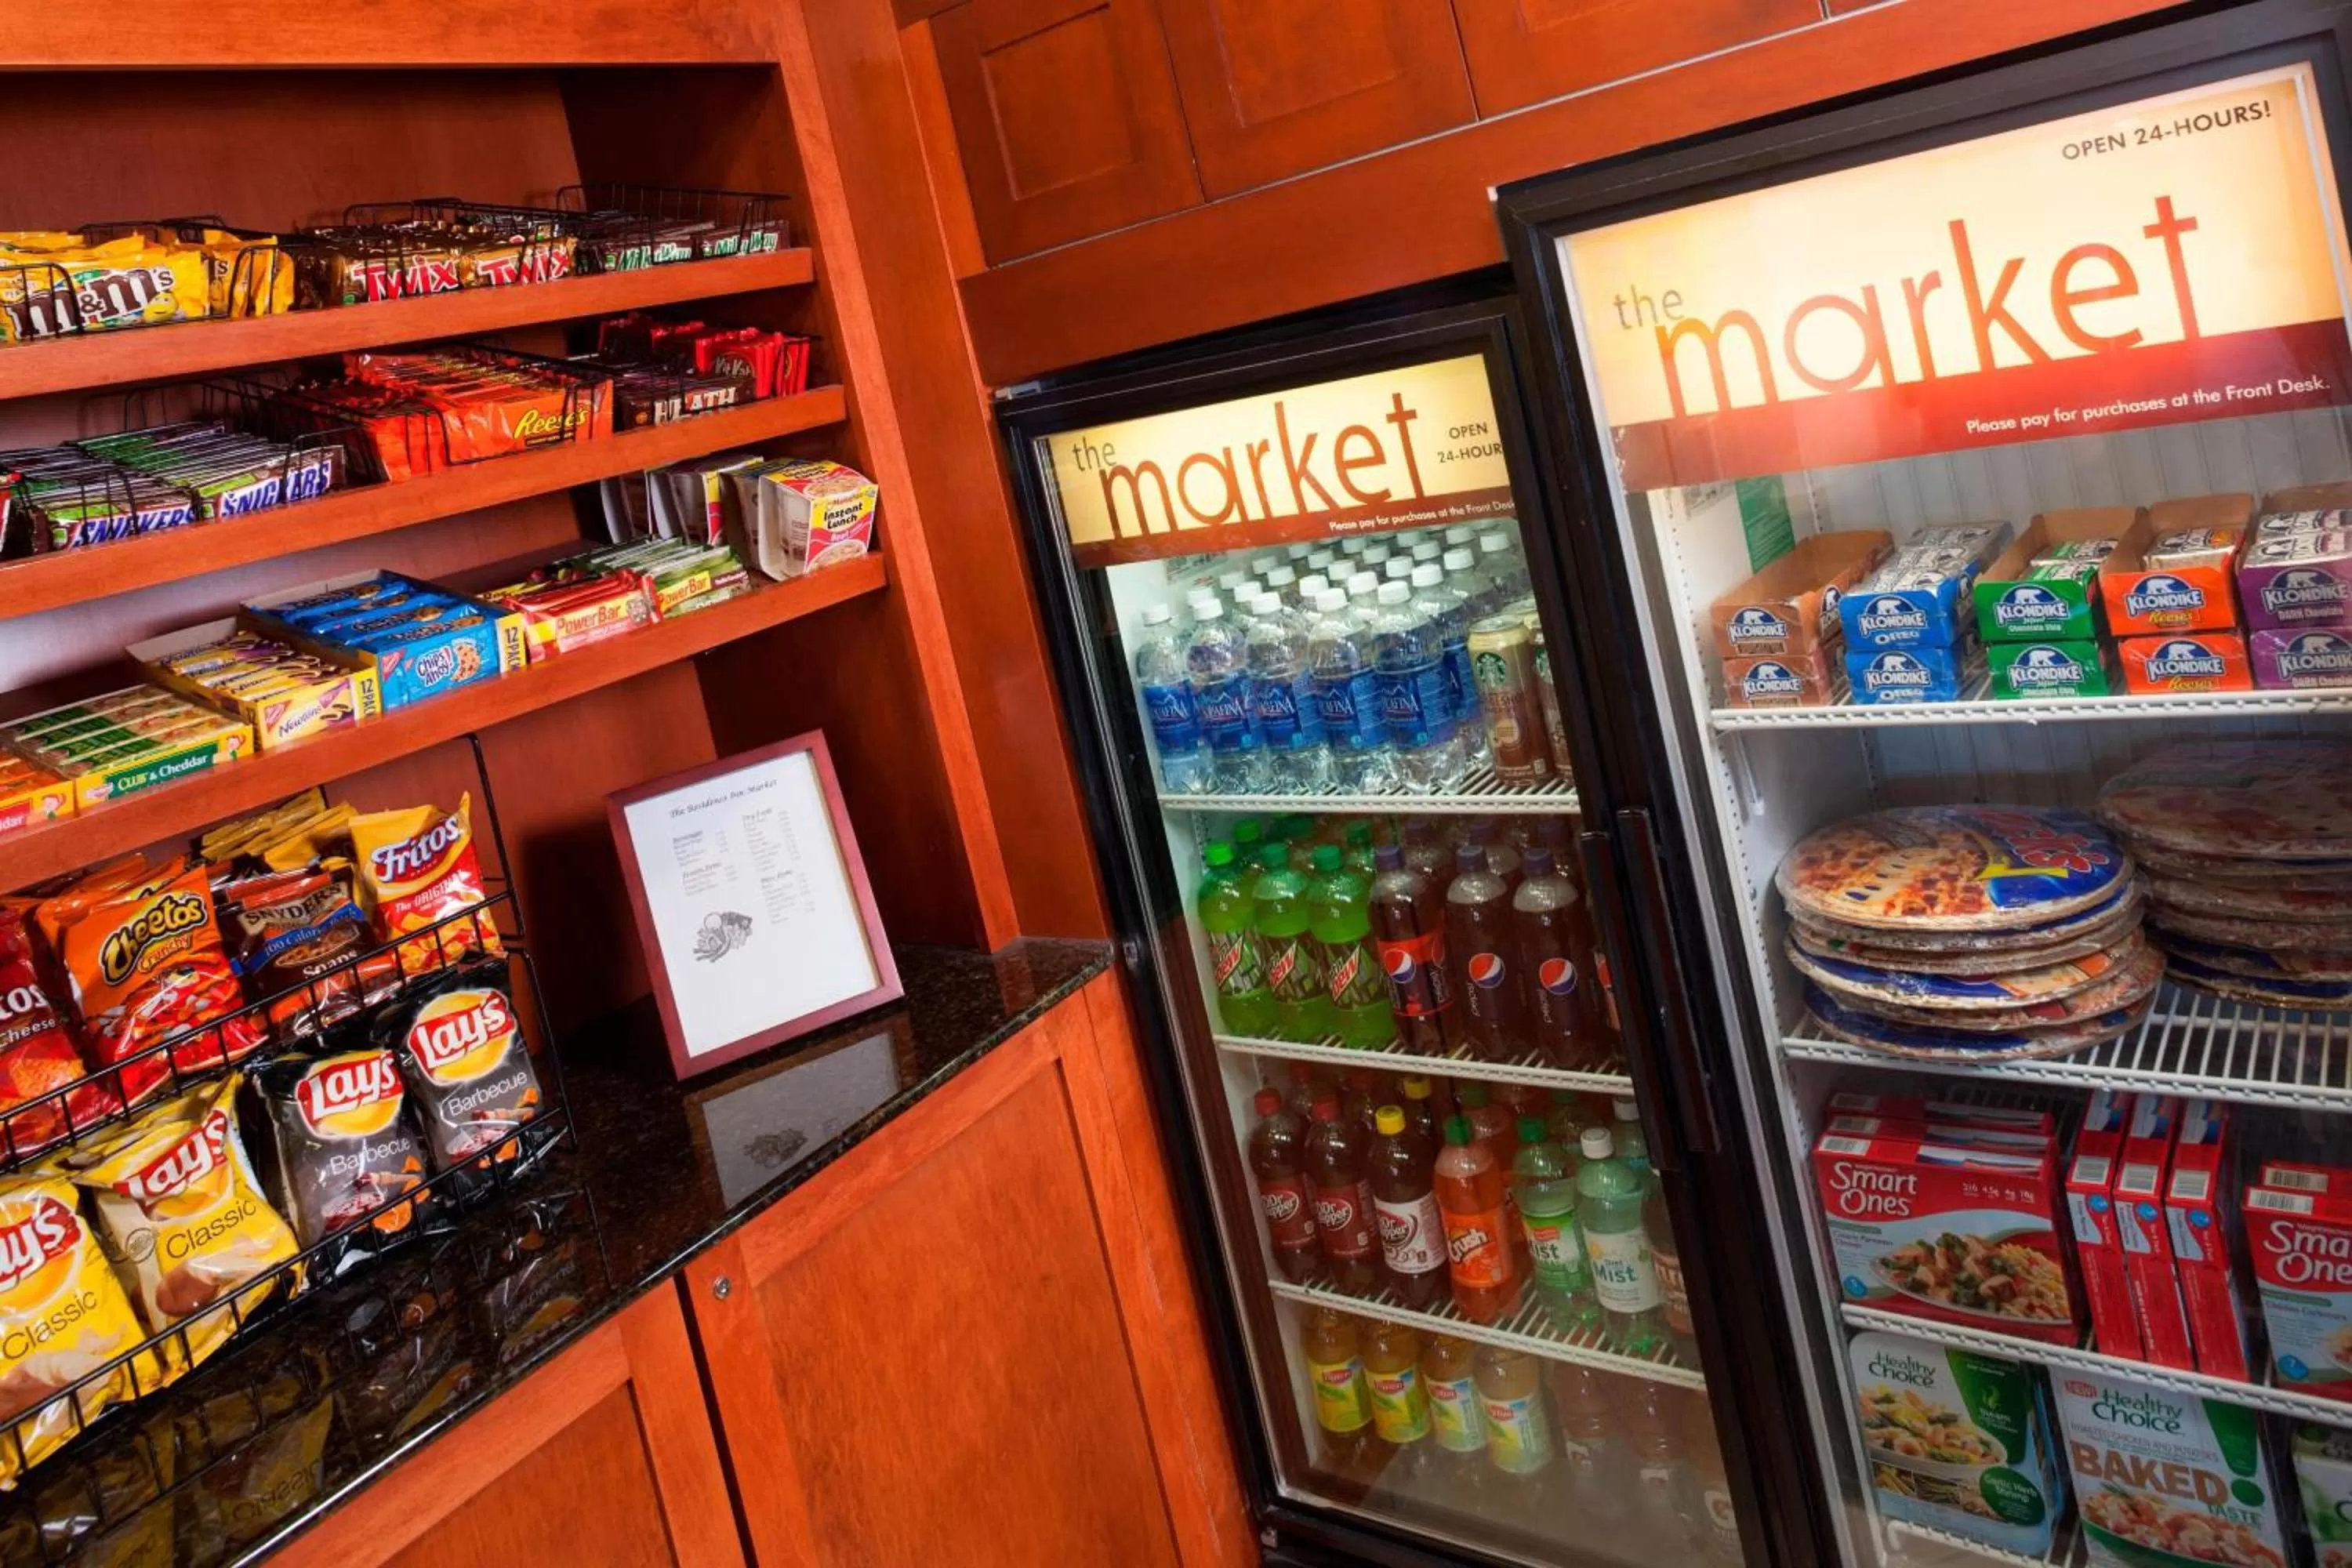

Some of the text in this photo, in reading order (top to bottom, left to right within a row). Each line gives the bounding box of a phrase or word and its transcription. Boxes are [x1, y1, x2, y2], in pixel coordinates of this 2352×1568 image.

[2062, 100, 2271, 160] OPEN 24-HOURS!
[1613, 283, 1685, 331] the
[1655, 194, 2201, 419] market
[1965, 374, 2331, 434] Please pay for purchases at the Front Desk.
[1449, 422, 1489, 439] OPEN
[1072, 436, 1116, 472] the
[1099, 393, 1425, 541] market
[824, 502, 863, 521] Instant
[827, 514, 858, 529] Lunch
[1330, 521, 1357, 531] Please
[1359, 518, 1374, 528] pay
[1376, 515, 1389, 524] for
[1392, 511, 1436, 525] purchases
[1439, 508, 1448, 517] at
[1450, 506, 1465, 516] the
[1465, 503, 1490, 514] Front
[1997, 602, 2068, 625] KLONDIKE
[2128, 592, 2203, 615] KLONDIKE
[2265, 585, 2348, 612] KLONDIKE
[555, 602, 621, 634] PowerBar
[1729, 623, 1786, 641] KLONDIKE
[1860, 612, 1927, 633] KLONDIKE
[504, 626, 518, 643] 12
[361, 678, 374, 694] 12
[1867, 670, 1929, 692] KLONDIKE
[2010, 666, 2081, 688] KLONDIKE
[2147, 659, 2223, 682] KLONDIKE
[1744, 680, 1801, 697] KLONDIKE
[159, 755, 208, 777] Cheddar
[372, 815, 460, 883] Fritos
[414, 870, 463, 906] ORIGIN
[100, 893, 208, 985] Cheetos
[416, 995, 508, 1071] Lay's
[307, 1053, 398, 1121] Lay's
[448, 1071, 528, 1117] Barbecue
[125, 1109, 229, 1207] Lay's
[328, 1137, 412, 1176] Barbecue
[1830, 1161, 1918, 1196] Smart
[1840, 1188, 1911, 1216] Ones
[166, 1199, 258, 1261] Classic
[2263, 1220, 2352, 1259] Sma
[1593, 1260, 1638, 1283] Mist
[2, 1289, 98, 1361] Classic
[1868, 1361, 1935, 1387] Choice
[1875, 1351, 1936, 1377] Healthy
[2092, 1401, 2183, 1436] Choice
[2102, 1388, 2183, 1420] Healthy
[2070, 1439, 2229, 1506] BAKED
